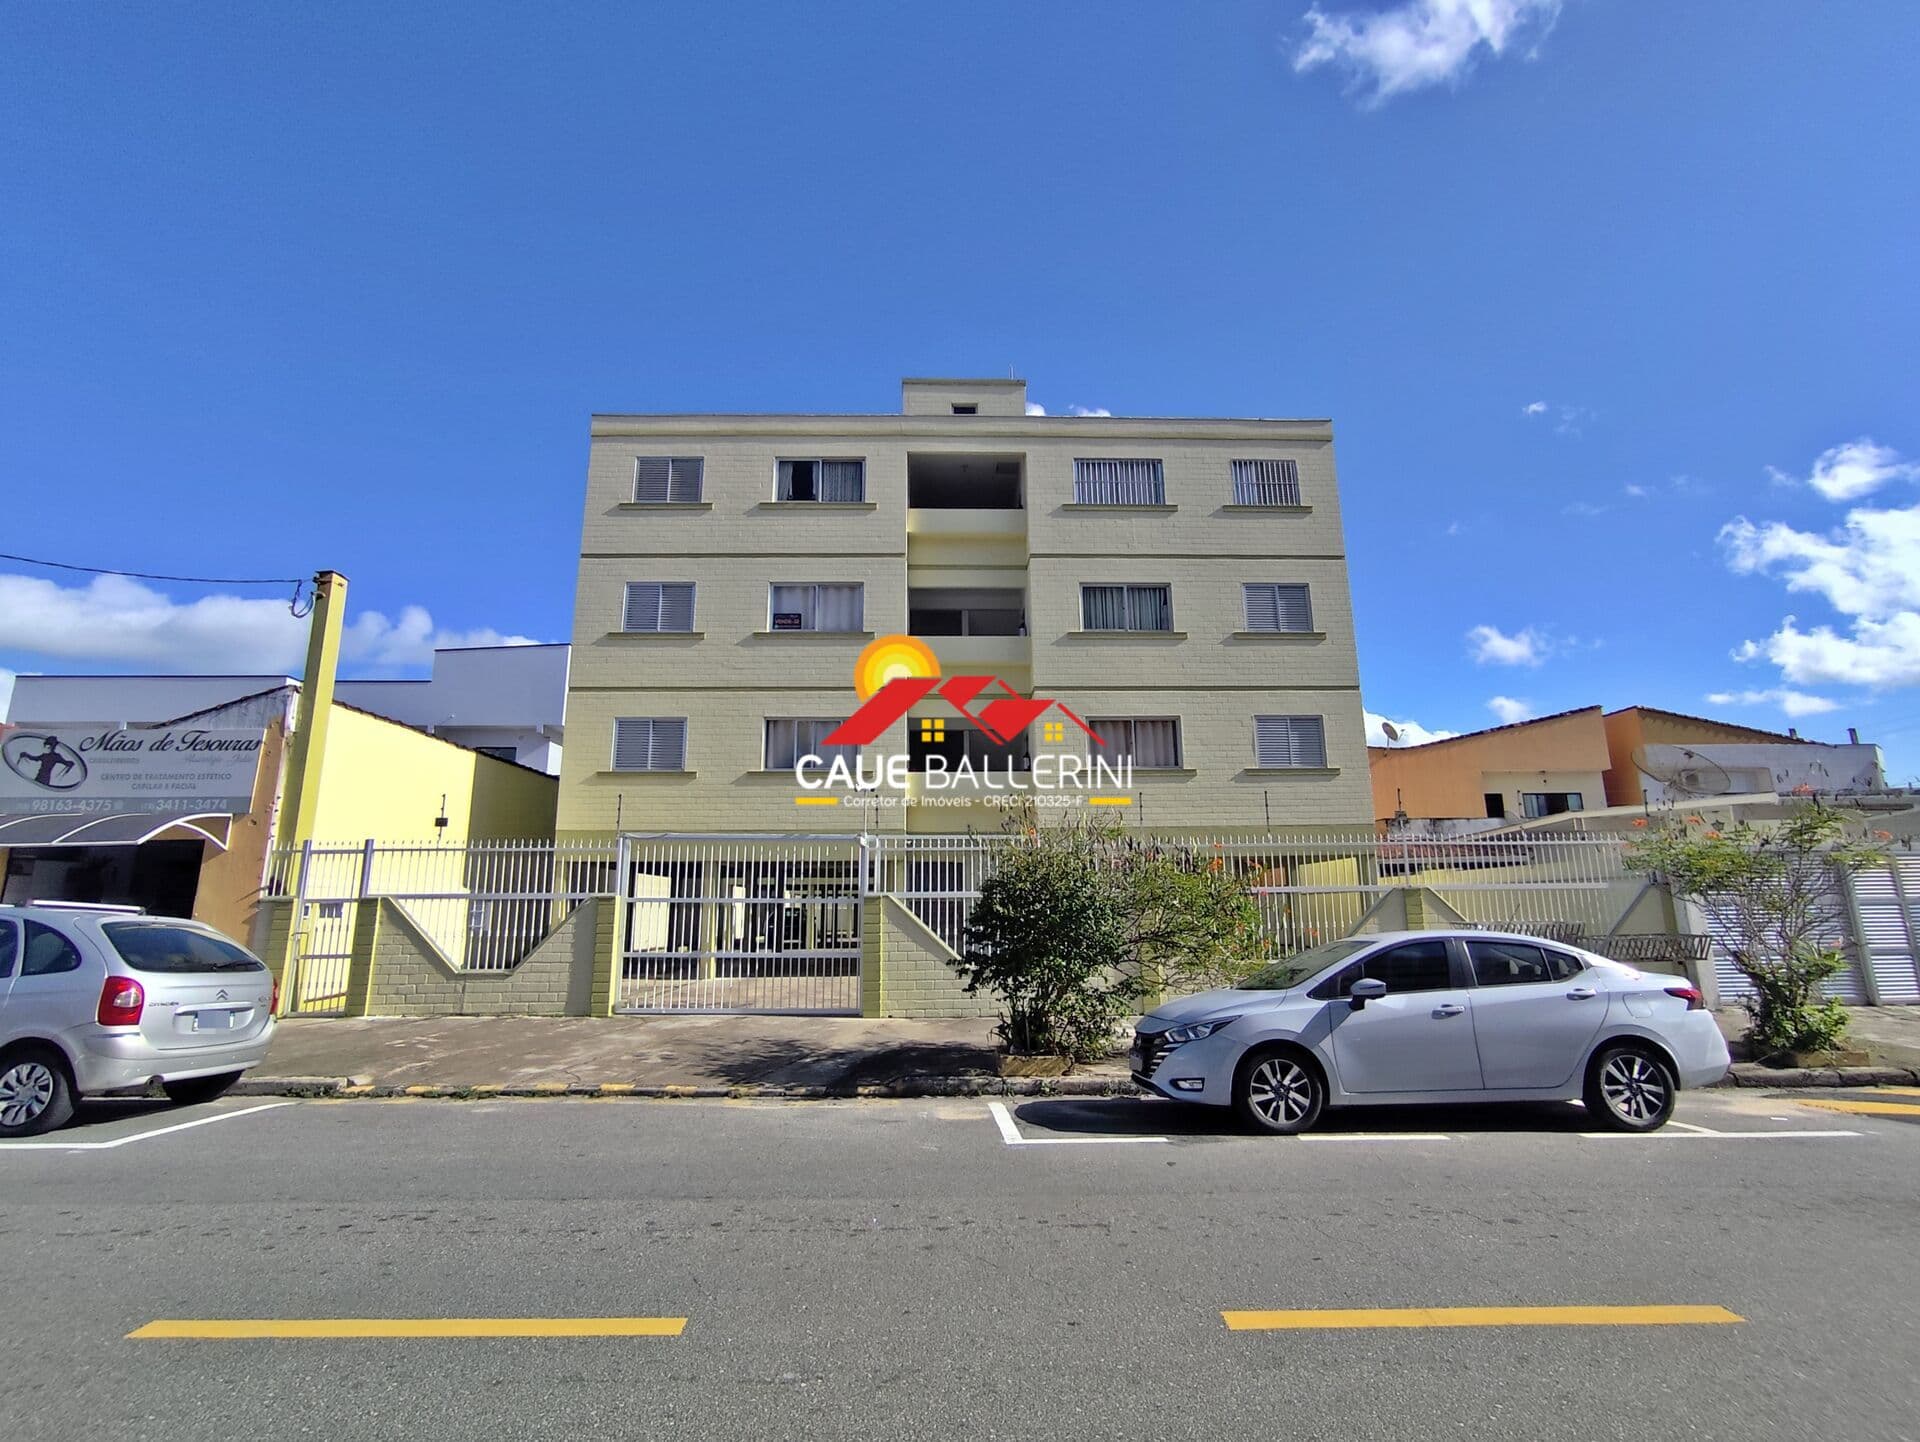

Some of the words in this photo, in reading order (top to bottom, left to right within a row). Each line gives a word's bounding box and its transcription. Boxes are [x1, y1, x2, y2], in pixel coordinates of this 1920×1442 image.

[79, 729, 144, 752] Mãos
[149, 732, 175, 752] de
[176, 730, 262, 752] Tesouras
[101, 773, 131, 781] CENTRO
[132, 773, 144, 781] DE
[145, 773, 196, 781] TRATAMENTO
